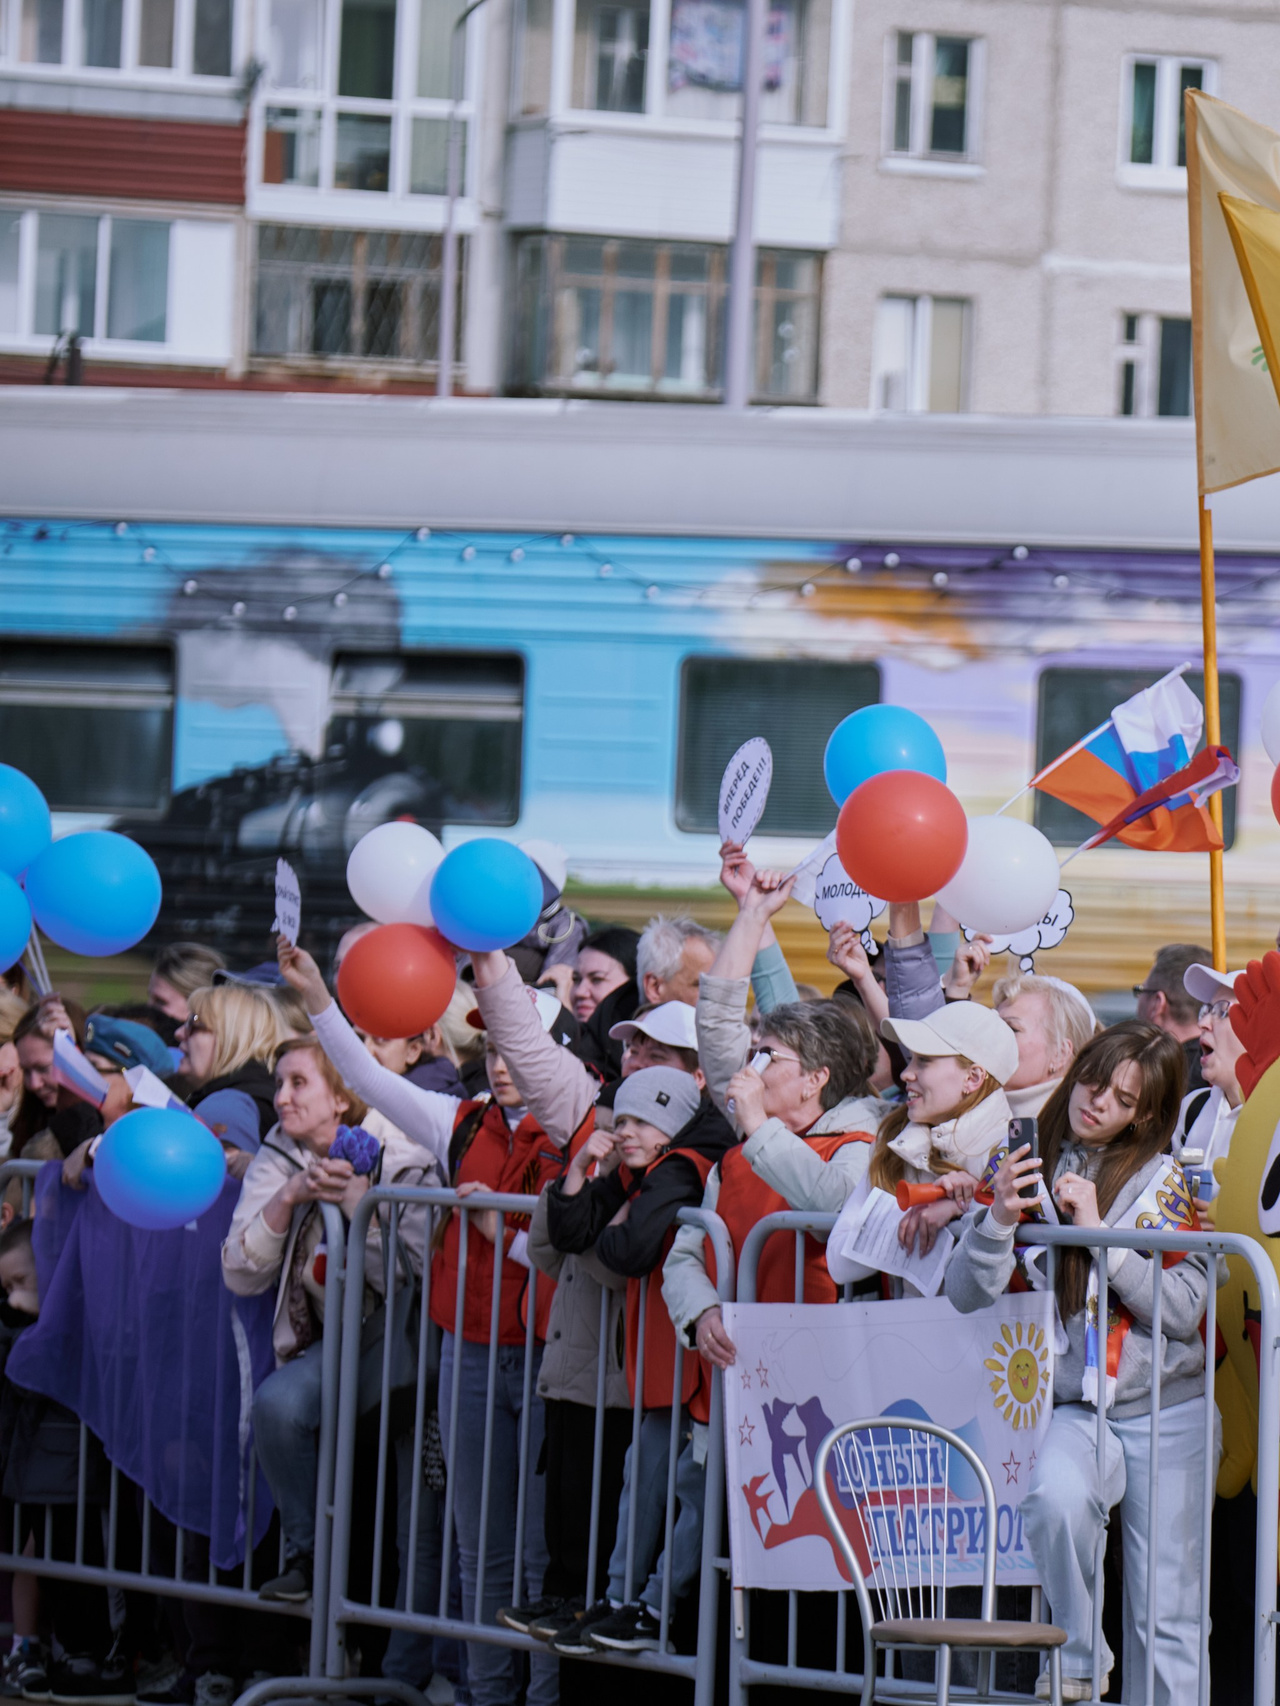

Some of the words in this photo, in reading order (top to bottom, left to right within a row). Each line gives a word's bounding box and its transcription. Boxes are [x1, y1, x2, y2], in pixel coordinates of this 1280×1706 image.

[723, 761, 750, 815] ВПЕРЁД
[731, 757, 767, 829] ПОБЕДЕ!!!
[835, 1431, 944, 1488] ЮНЫЙ
